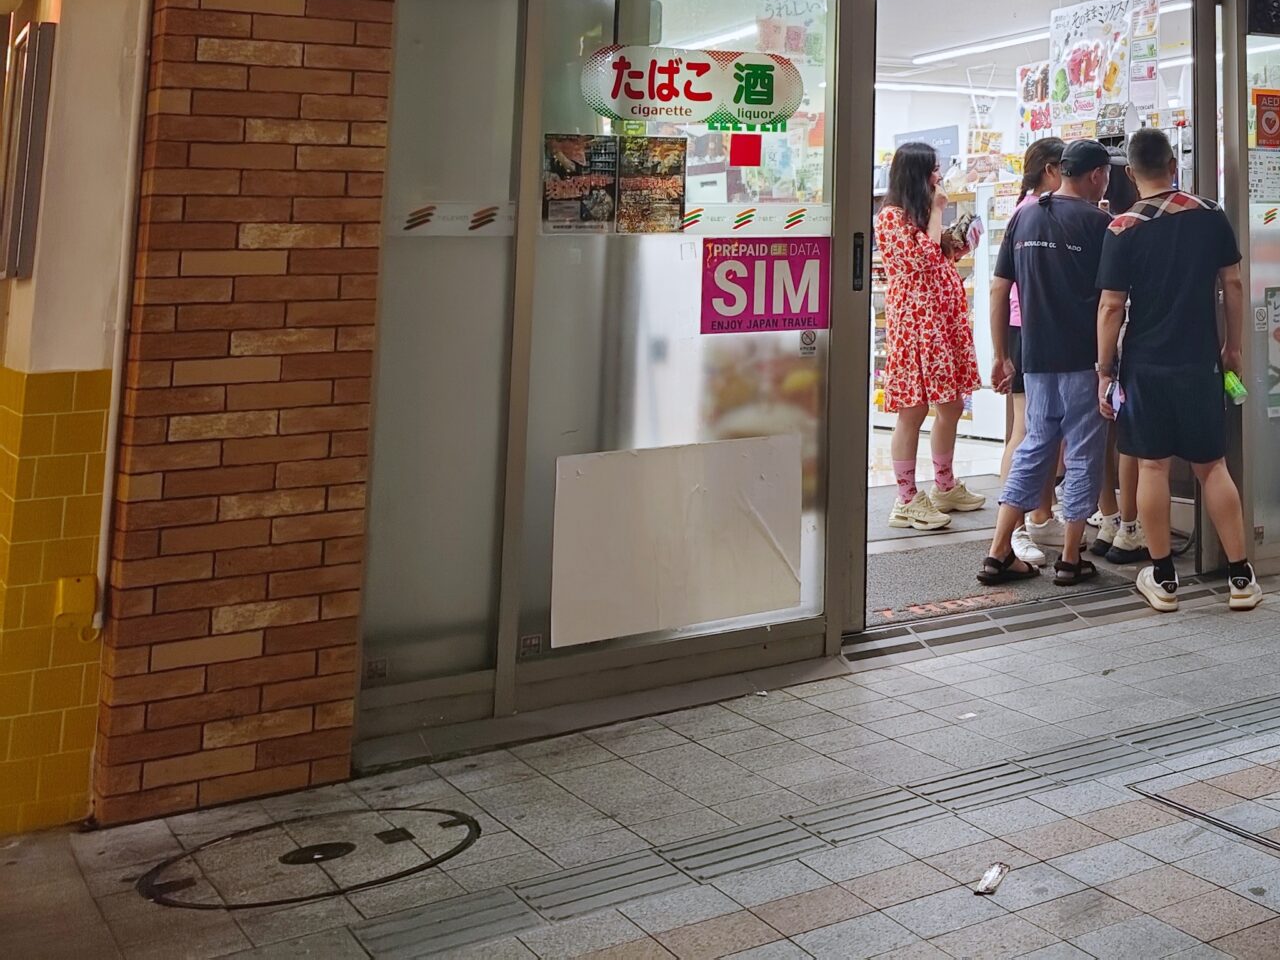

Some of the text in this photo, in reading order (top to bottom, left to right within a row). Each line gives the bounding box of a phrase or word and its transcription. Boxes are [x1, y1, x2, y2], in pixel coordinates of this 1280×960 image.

[611, 56, 775, 106] たばこ 酒
[1261, 96, 1280, 106] AED
[631, 104, 775, 119] cigarette liquor
[713, 243, 821, 257] PREPAID DATA
[711, 259, 821, 317] SIM
[711, 316, 818, 330] ENJOY JAPAN TRAVEL
